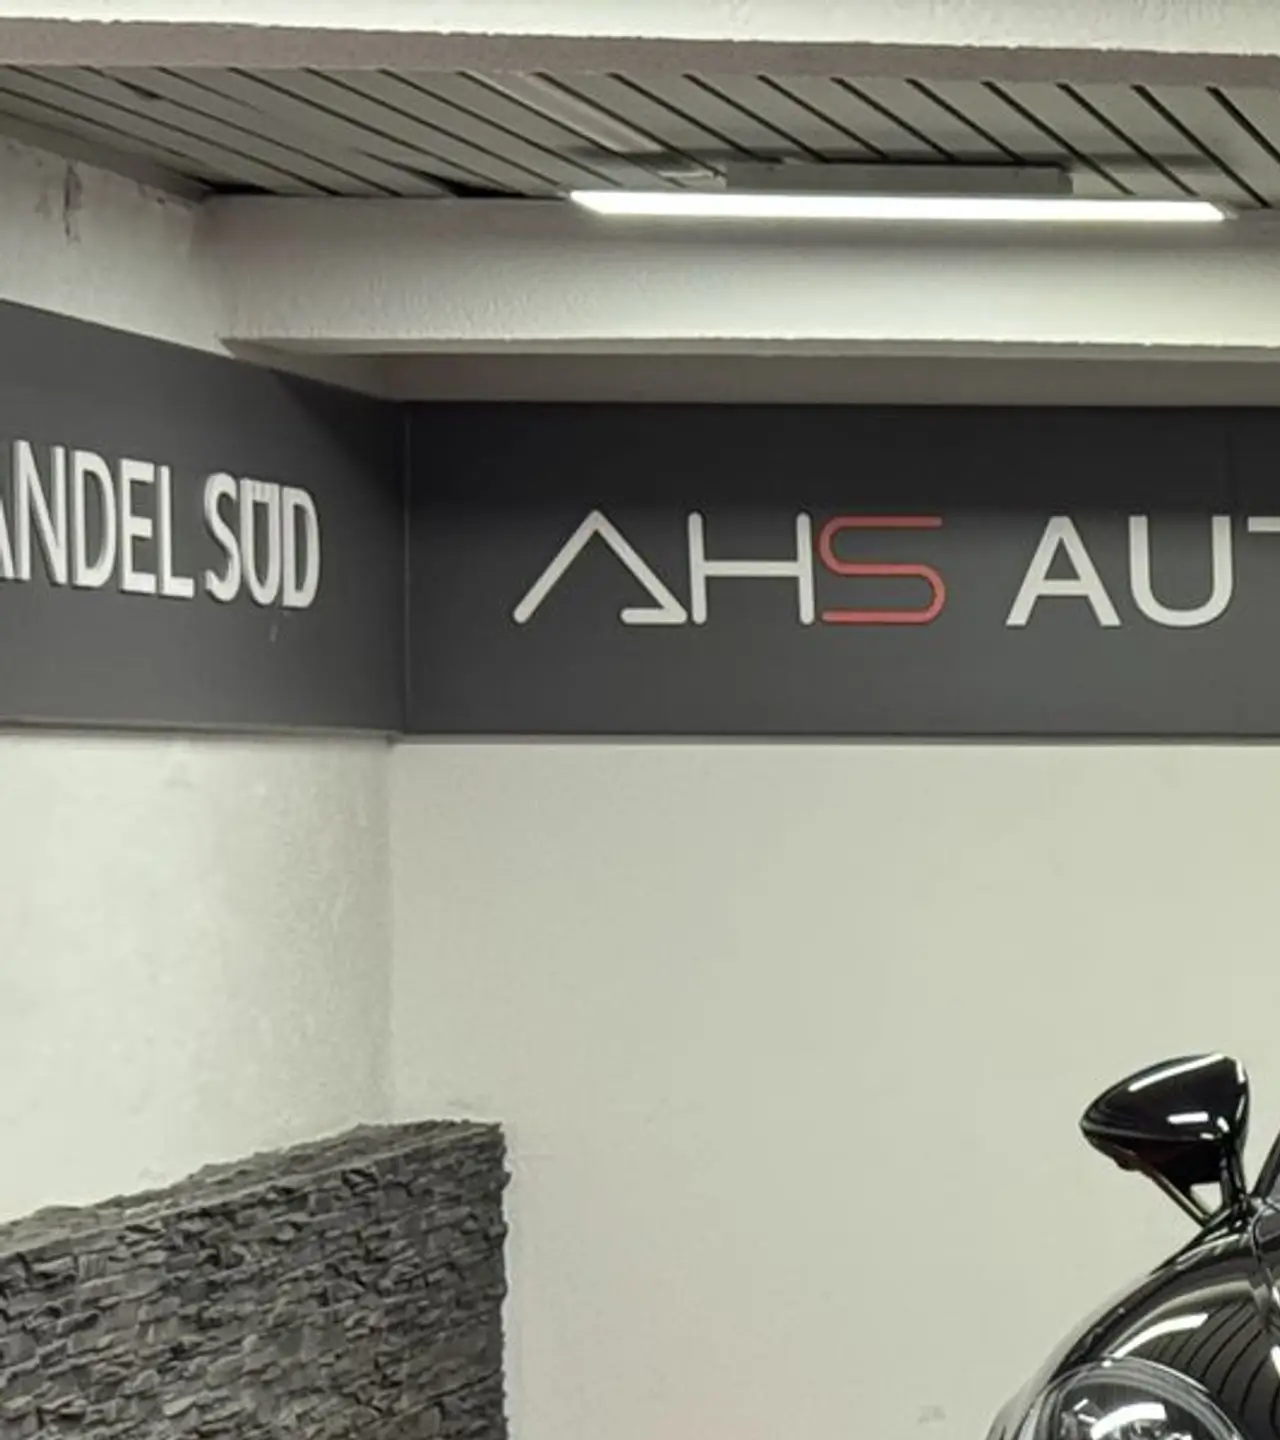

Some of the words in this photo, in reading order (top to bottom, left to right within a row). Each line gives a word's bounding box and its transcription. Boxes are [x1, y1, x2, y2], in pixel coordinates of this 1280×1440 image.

[0, 438, 196, 599] NDEL
[202, 471, 321, 608] SÜD
[511, 509, 947, 626] AHS
